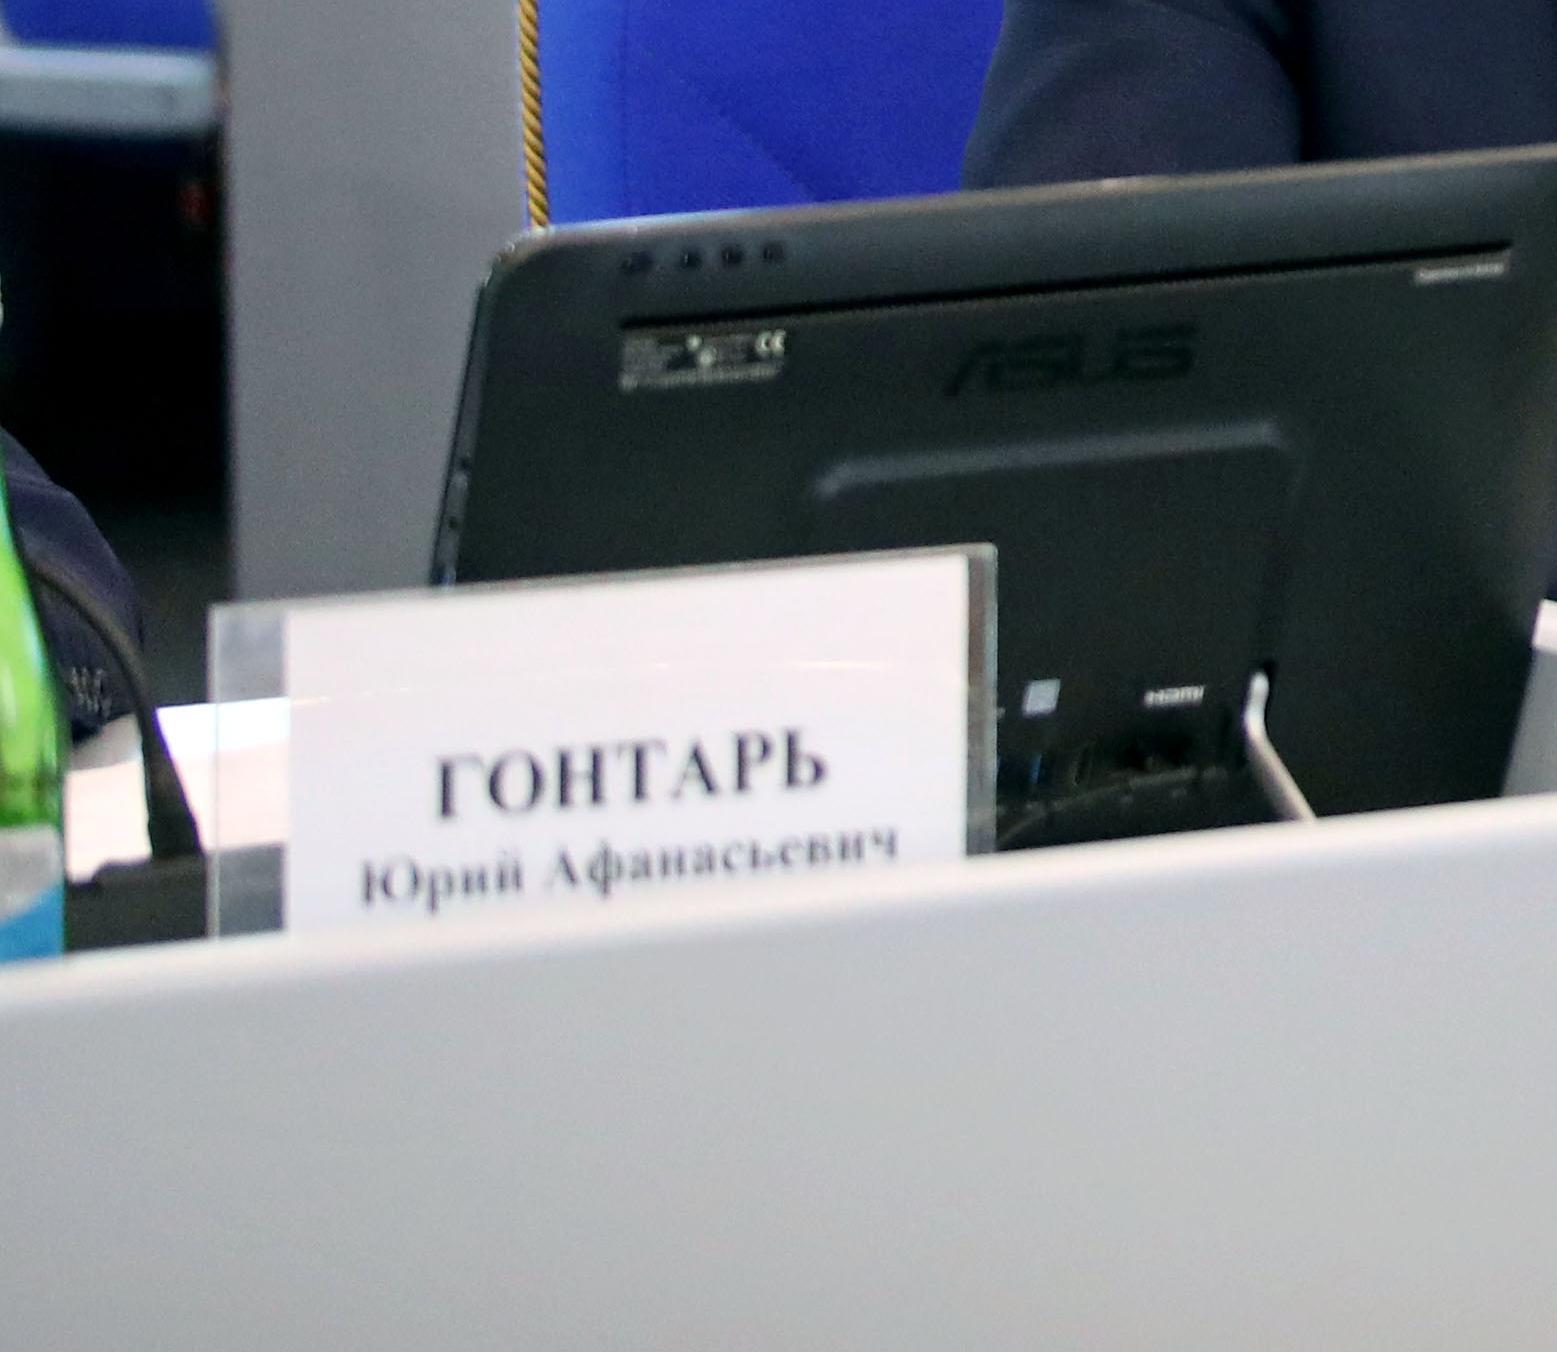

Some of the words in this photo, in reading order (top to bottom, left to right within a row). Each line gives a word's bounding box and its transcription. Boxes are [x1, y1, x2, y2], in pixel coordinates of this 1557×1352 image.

[437, 727, 827, 821] ГОНТАРЬ
[362, 850, 524, 913] Юрий
[544, 827, 897, 898] Афанасьевич
